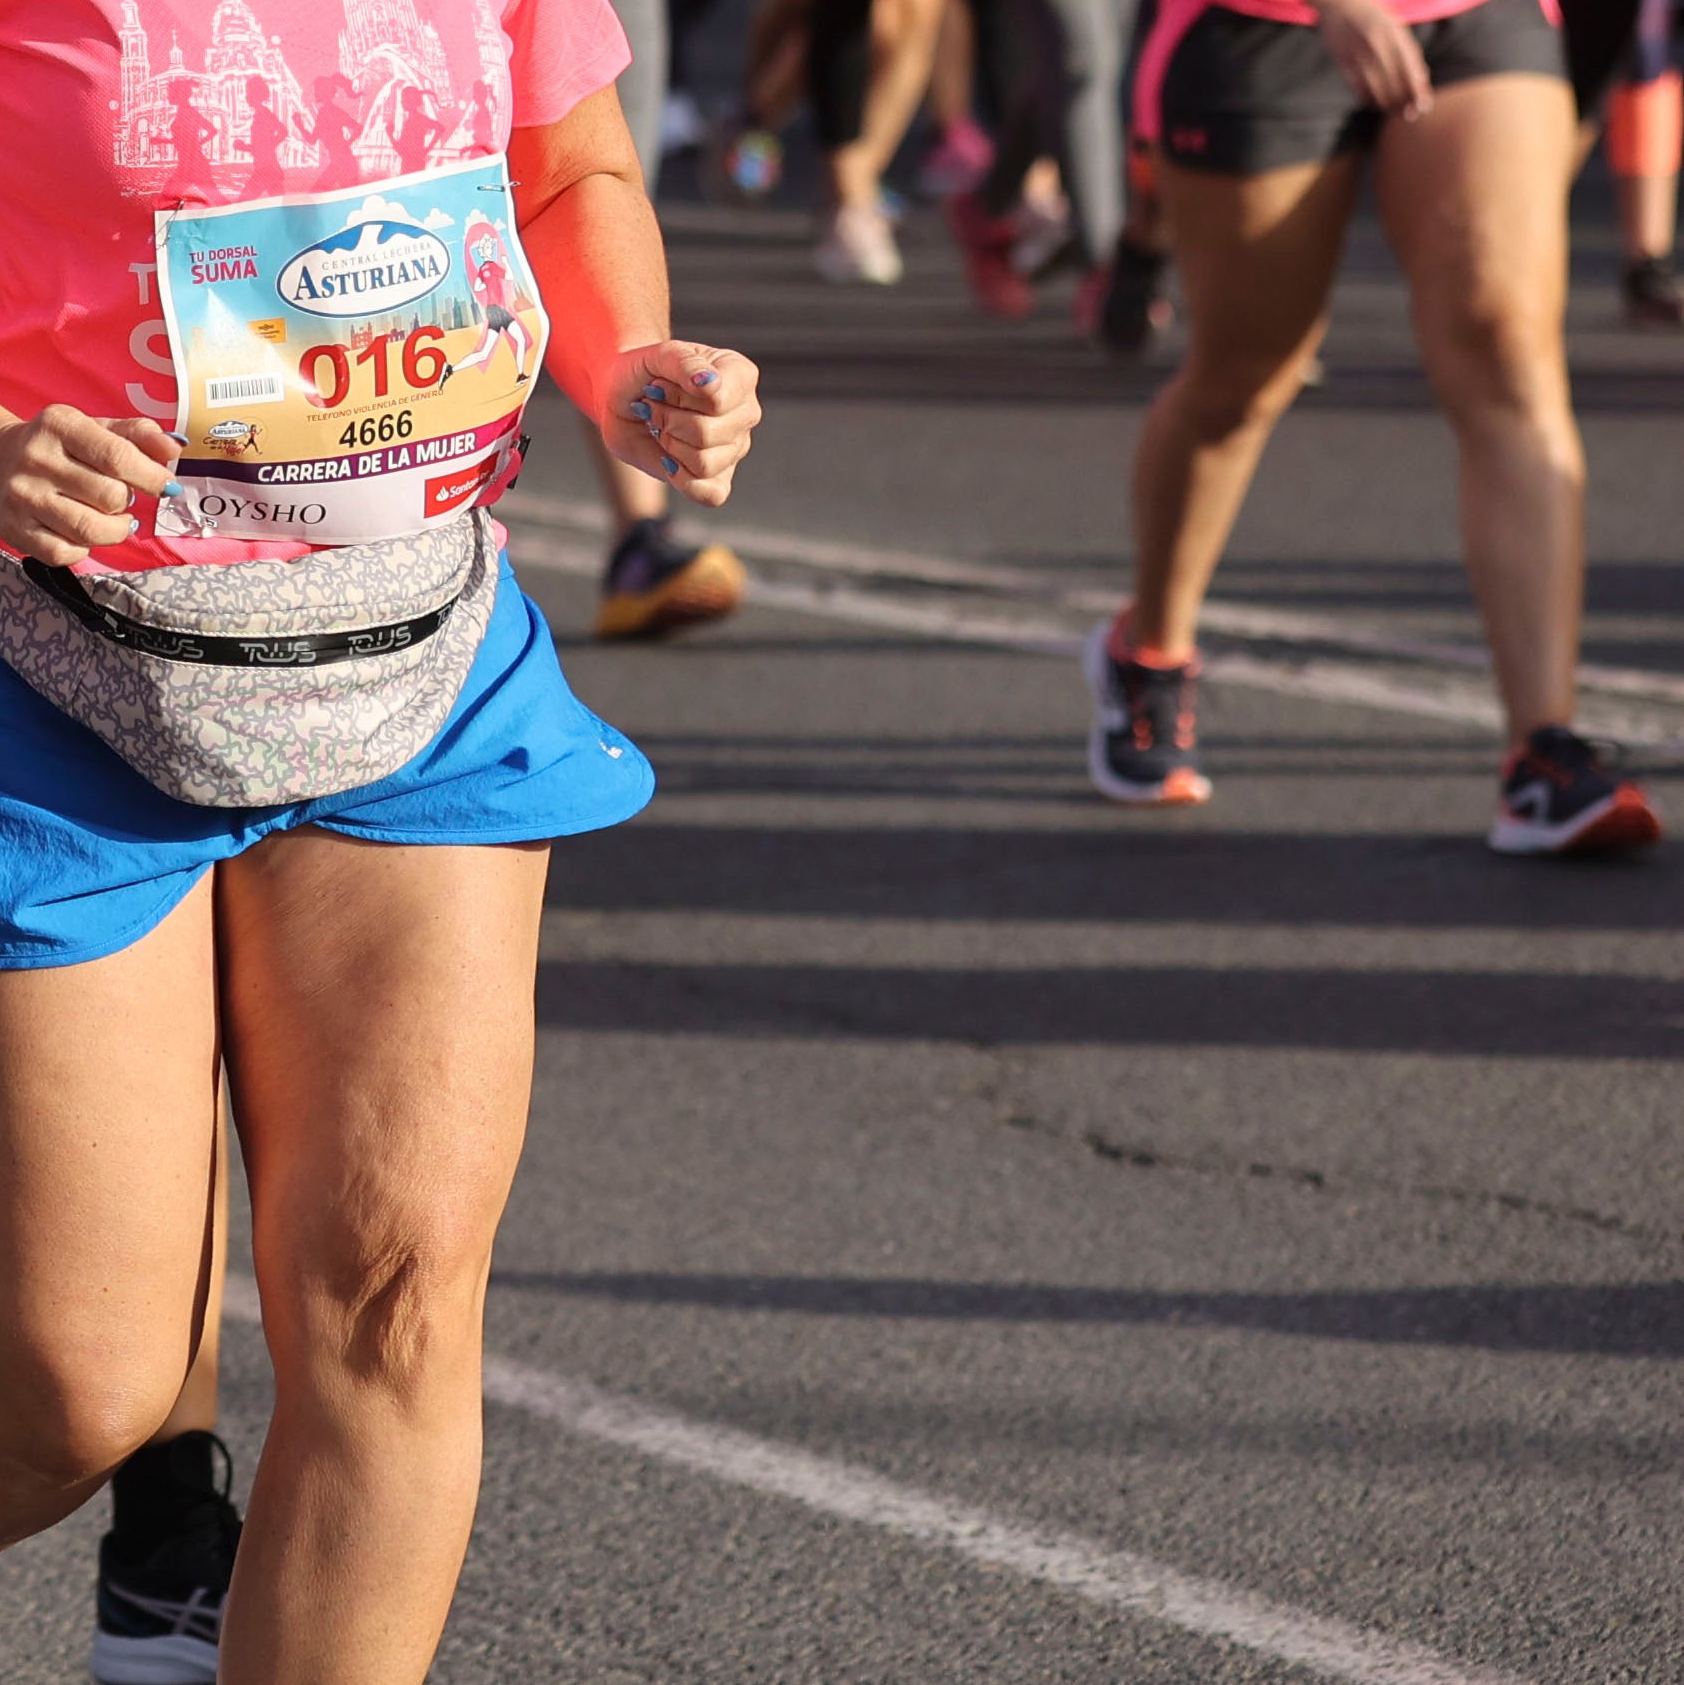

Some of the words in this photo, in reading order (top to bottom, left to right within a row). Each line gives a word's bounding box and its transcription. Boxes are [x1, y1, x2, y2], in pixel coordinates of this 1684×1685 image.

[189, 251, 205, 264] TU
[208, 245, 258, 261] DORSAL
[321, 252, 379, 272] CENTRAL
[382, 241, 432, 260] LECHERA
[191, 259, 259, 285] SUMA
[293, 254, 442, 301] ASTURIANA
[298, 324, 448, 409] 016
[353, 399, 397, 415] VIOLENCIA
[398, 396, 409, 405] DE
[338, 409, 414, 449] 4666
[257, 458, 351, 483] CARRERA
[358, 452, 382, 475] DE
[387, 447, 411, 470] LA
[416, 432, 476, 464] MUJER
[199, 494, 327, 525] OYSHO
